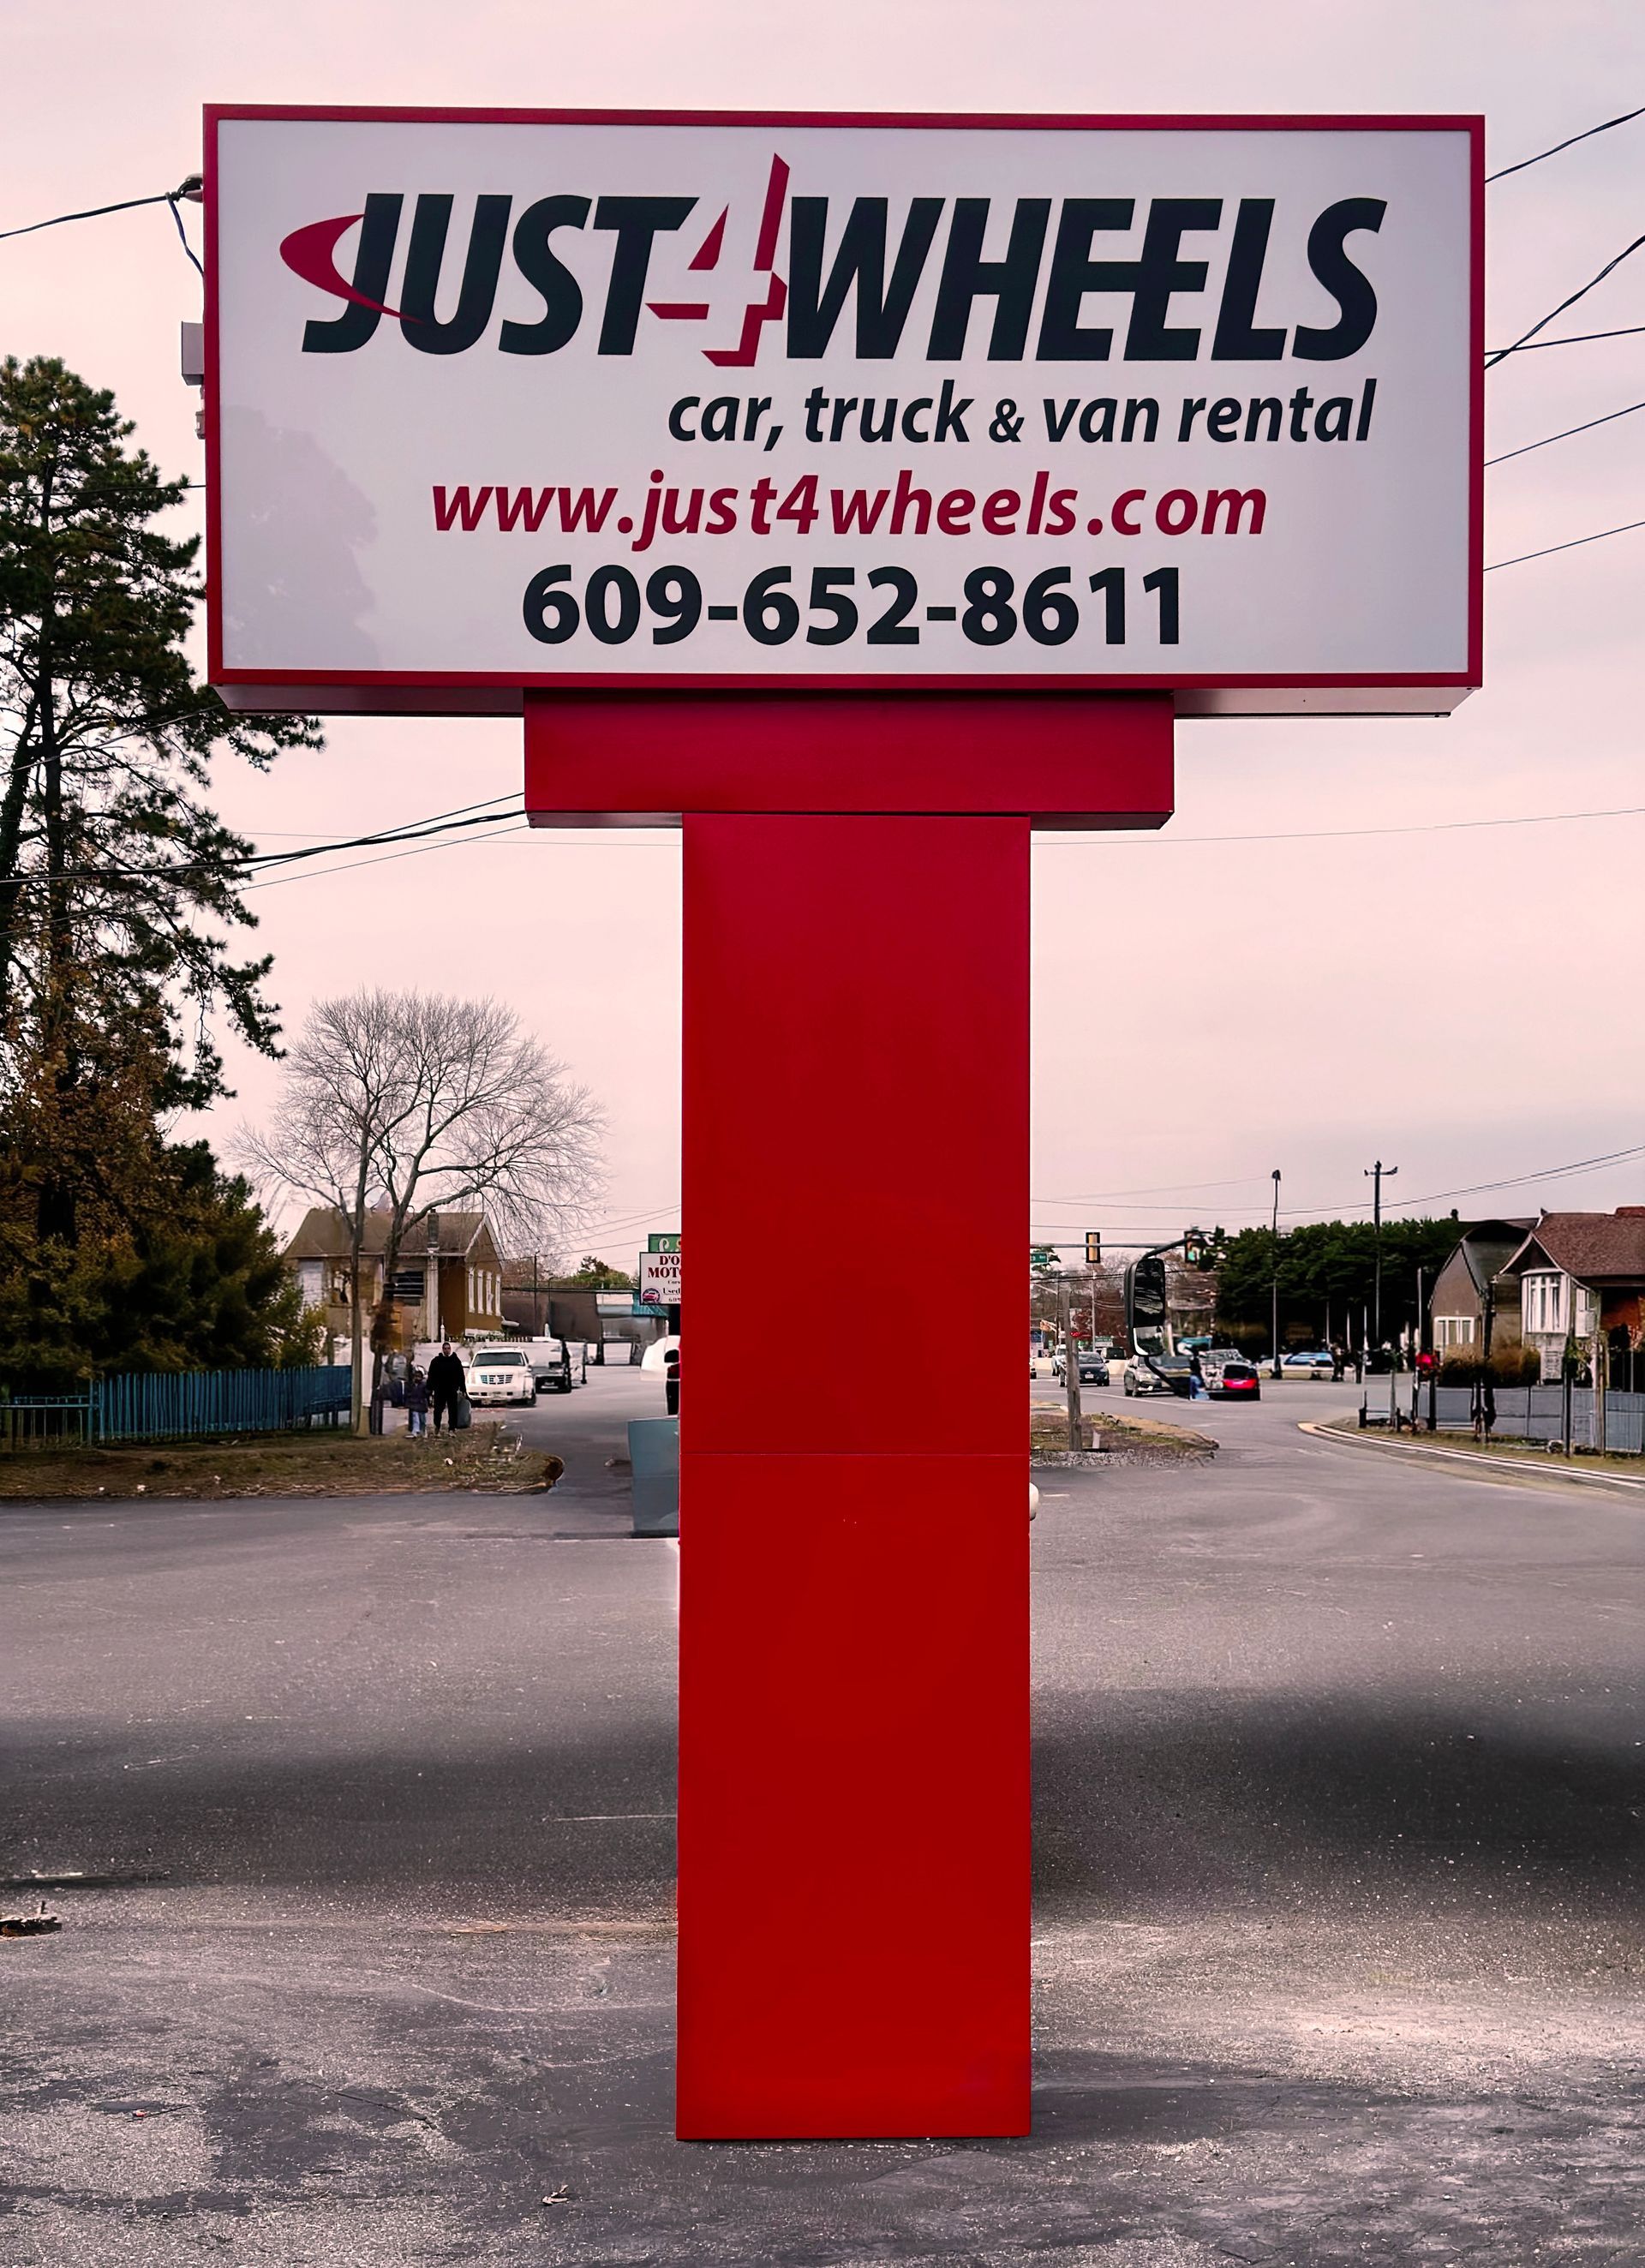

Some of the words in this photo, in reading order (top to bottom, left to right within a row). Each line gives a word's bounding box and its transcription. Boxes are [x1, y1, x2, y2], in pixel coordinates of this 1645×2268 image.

[668, 396, 784, 452] car,
[804, 379, 975, 444] truck
[988, 398, 1025, 443] &
[1043, 398, 1160, 444] van
[1177, 378, 1378, 444] rental
[432, 469, 1267, 554] www.just4wheels.com
[523, 564, 1180, 647] 609-652-8611
[648, 1267, 681, 1278] MOT
